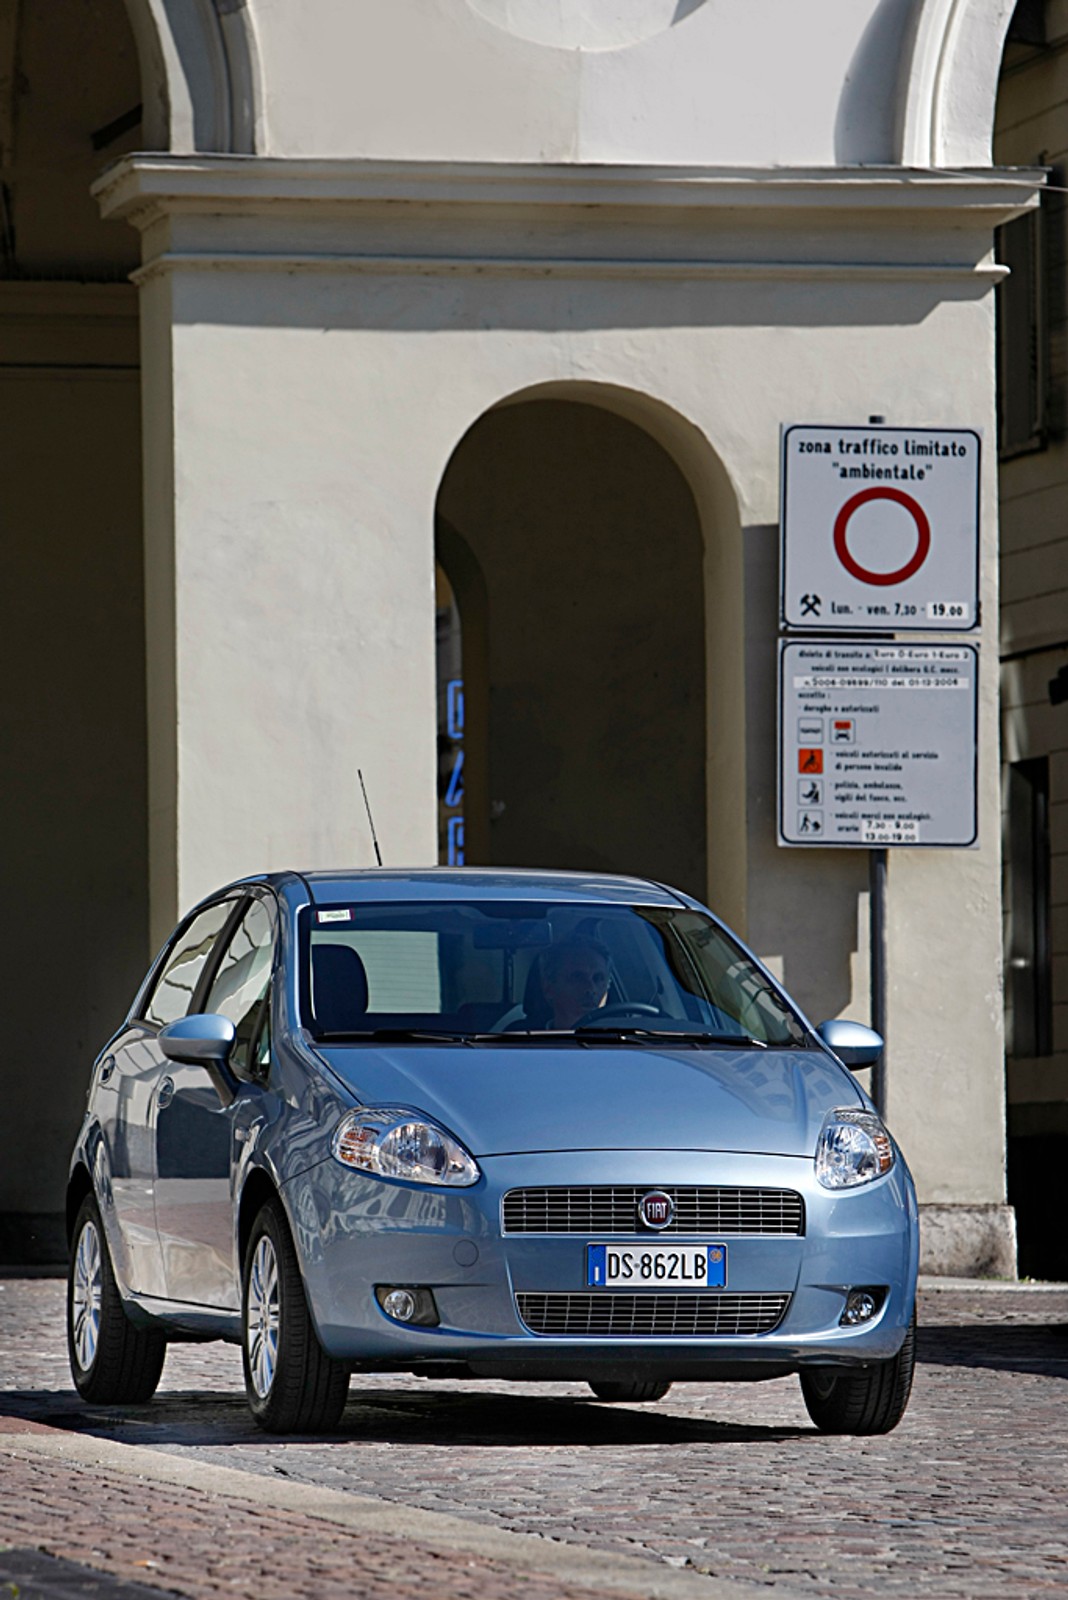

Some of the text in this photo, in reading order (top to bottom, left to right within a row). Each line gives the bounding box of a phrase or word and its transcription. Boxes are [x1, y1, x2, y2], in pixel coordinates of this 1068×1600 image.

[799, 439, 967, 457] zona traffico limitato
[832, 462, 933, 480] "ambientale"
[867, 604, 890, 616] ven.
[646, 1202, 668, 1219] FIAT
